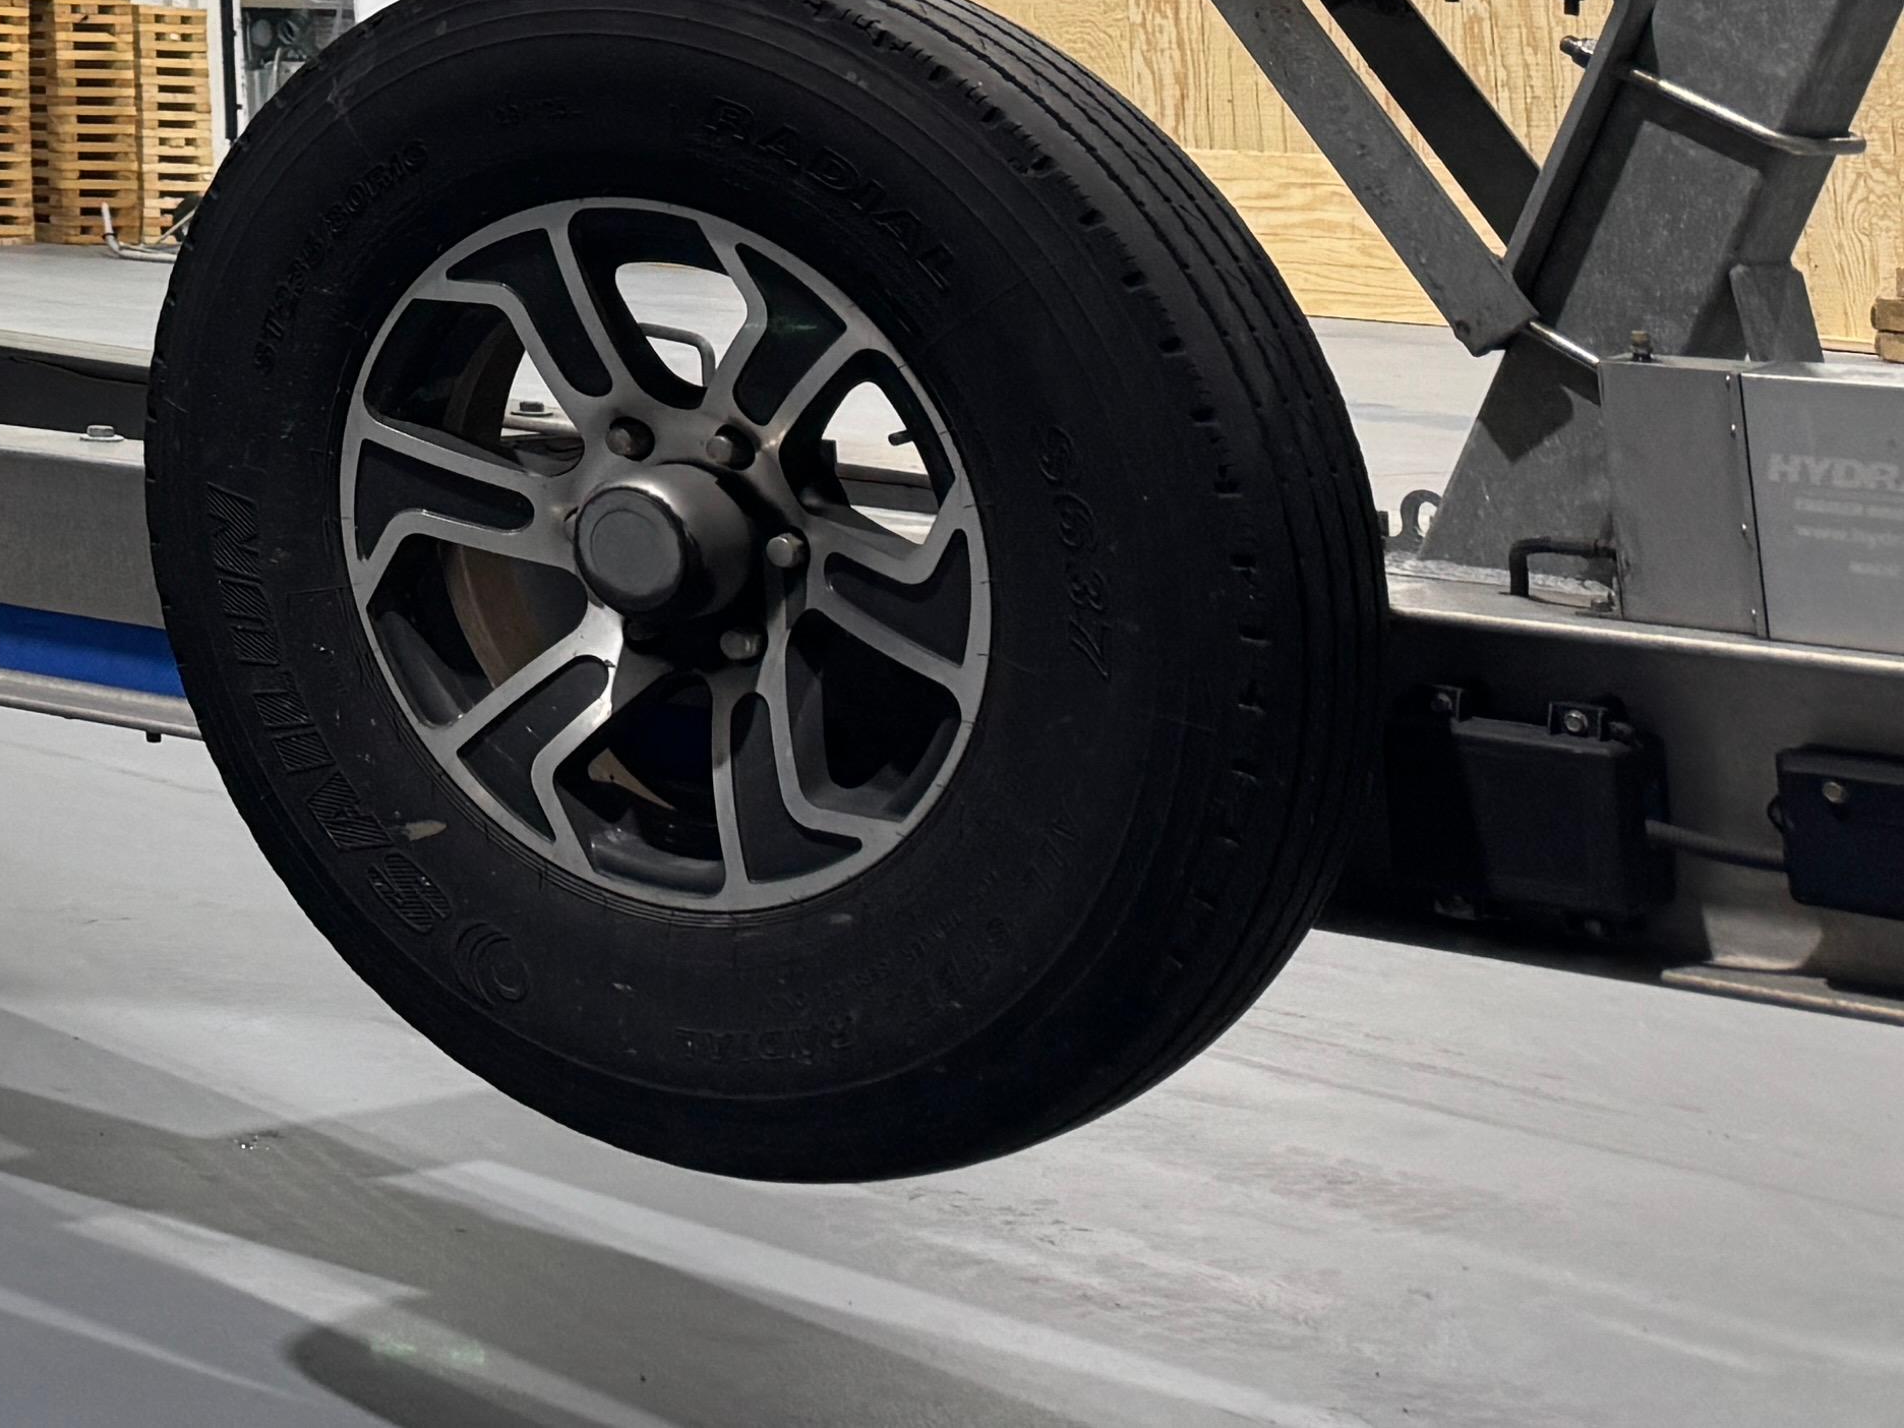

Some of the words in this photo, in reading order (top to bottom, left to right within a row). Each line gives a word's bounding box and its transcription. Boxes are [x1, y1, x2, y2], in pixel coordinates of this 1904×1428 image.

[703, 95, 961, 295] RADIAL
[1767, 452, 1904, 492] HYDR
[203, 482, 454, 936] SAILUN
